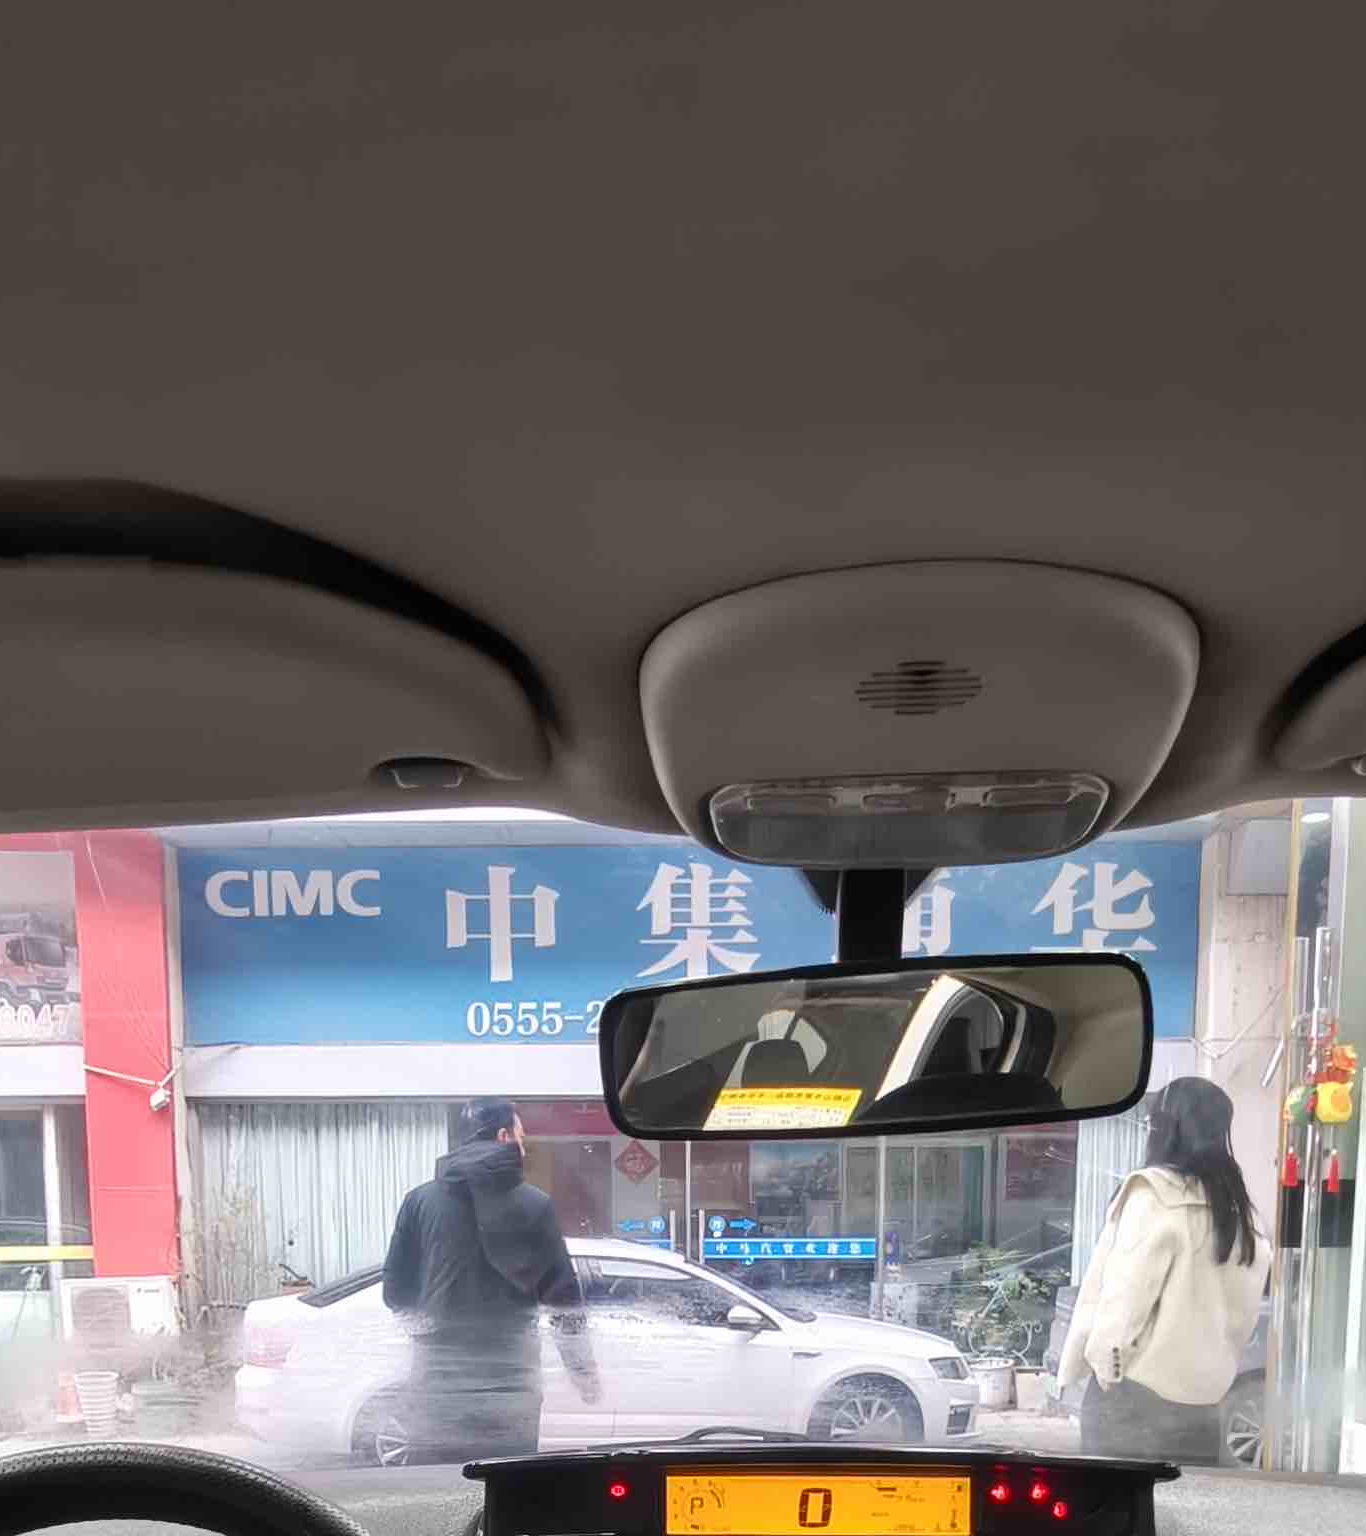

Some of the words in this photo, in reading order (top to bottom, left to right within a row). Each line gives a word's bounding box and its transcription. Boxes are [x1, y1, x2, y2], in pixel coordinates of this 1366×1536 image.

[204, 869, 381, 918] CIMC
[690, 1496, 704, 1515] P
[798, 1487, 833, 1529] 0
